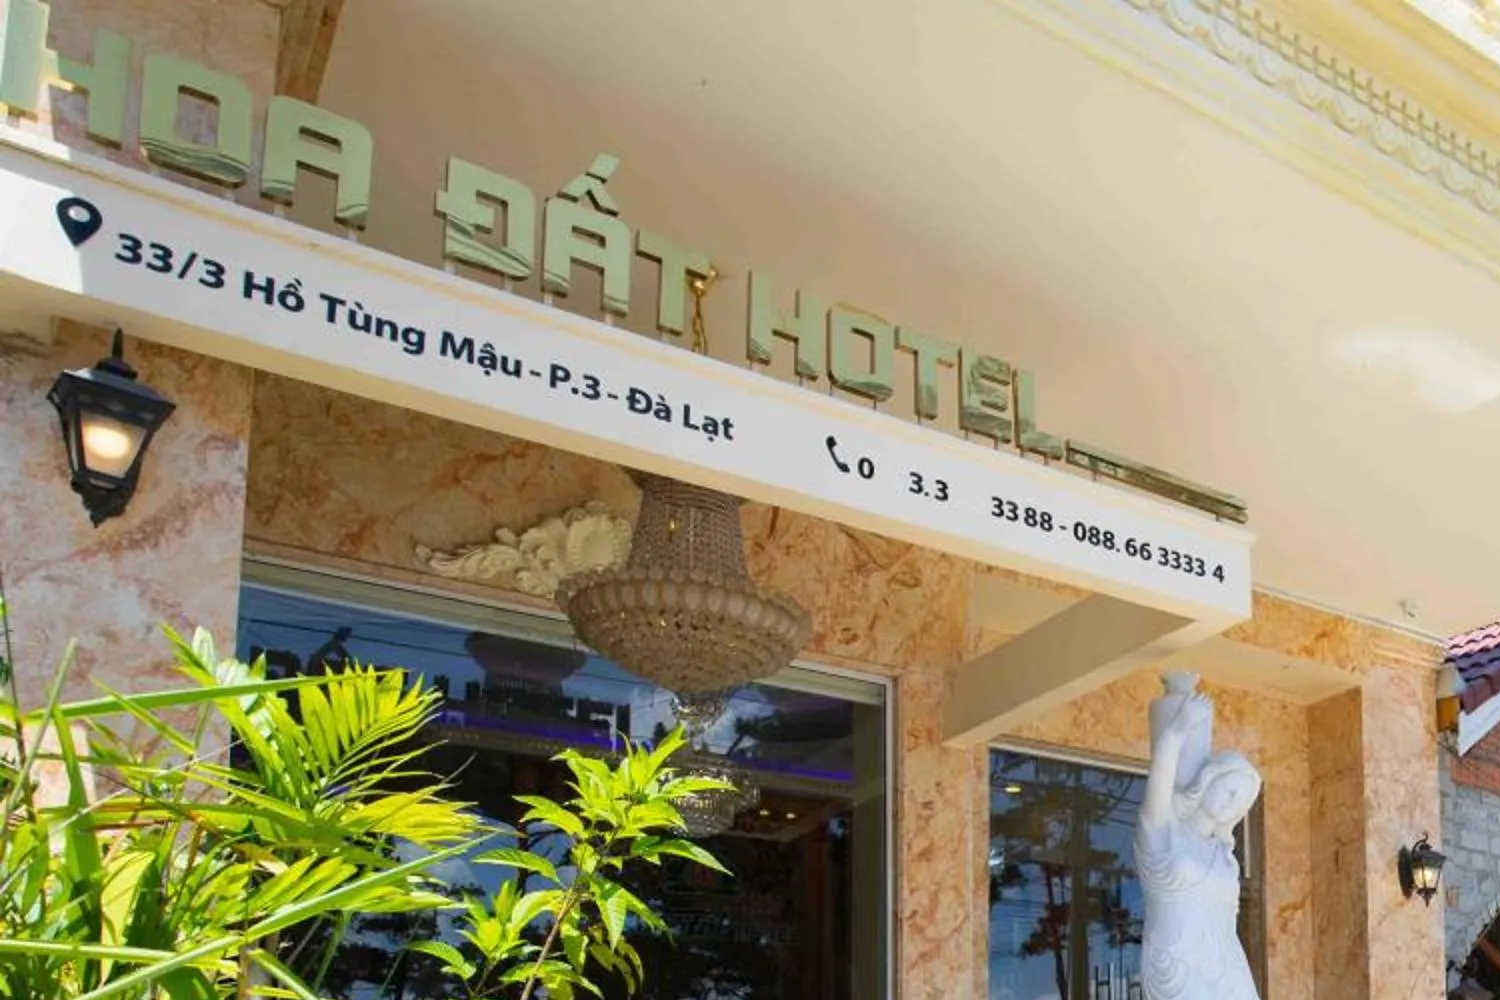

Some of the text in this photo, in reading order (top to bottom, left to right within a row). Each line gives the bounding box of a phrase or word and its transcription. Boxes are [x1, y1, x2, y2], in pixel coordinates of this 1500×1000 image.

[0, 0, 1063, 460] HOA ĐẤT HOTEL
[115, 232, 226, 289] 33/3
[243, 271, 305, 313] Hồ
[320, 293, 426, 355] Tùng
[440, 331, 522, 376] Mậu
[626, 387, 672, 423] Đà
[683, 404, 734, 442] Lạt
